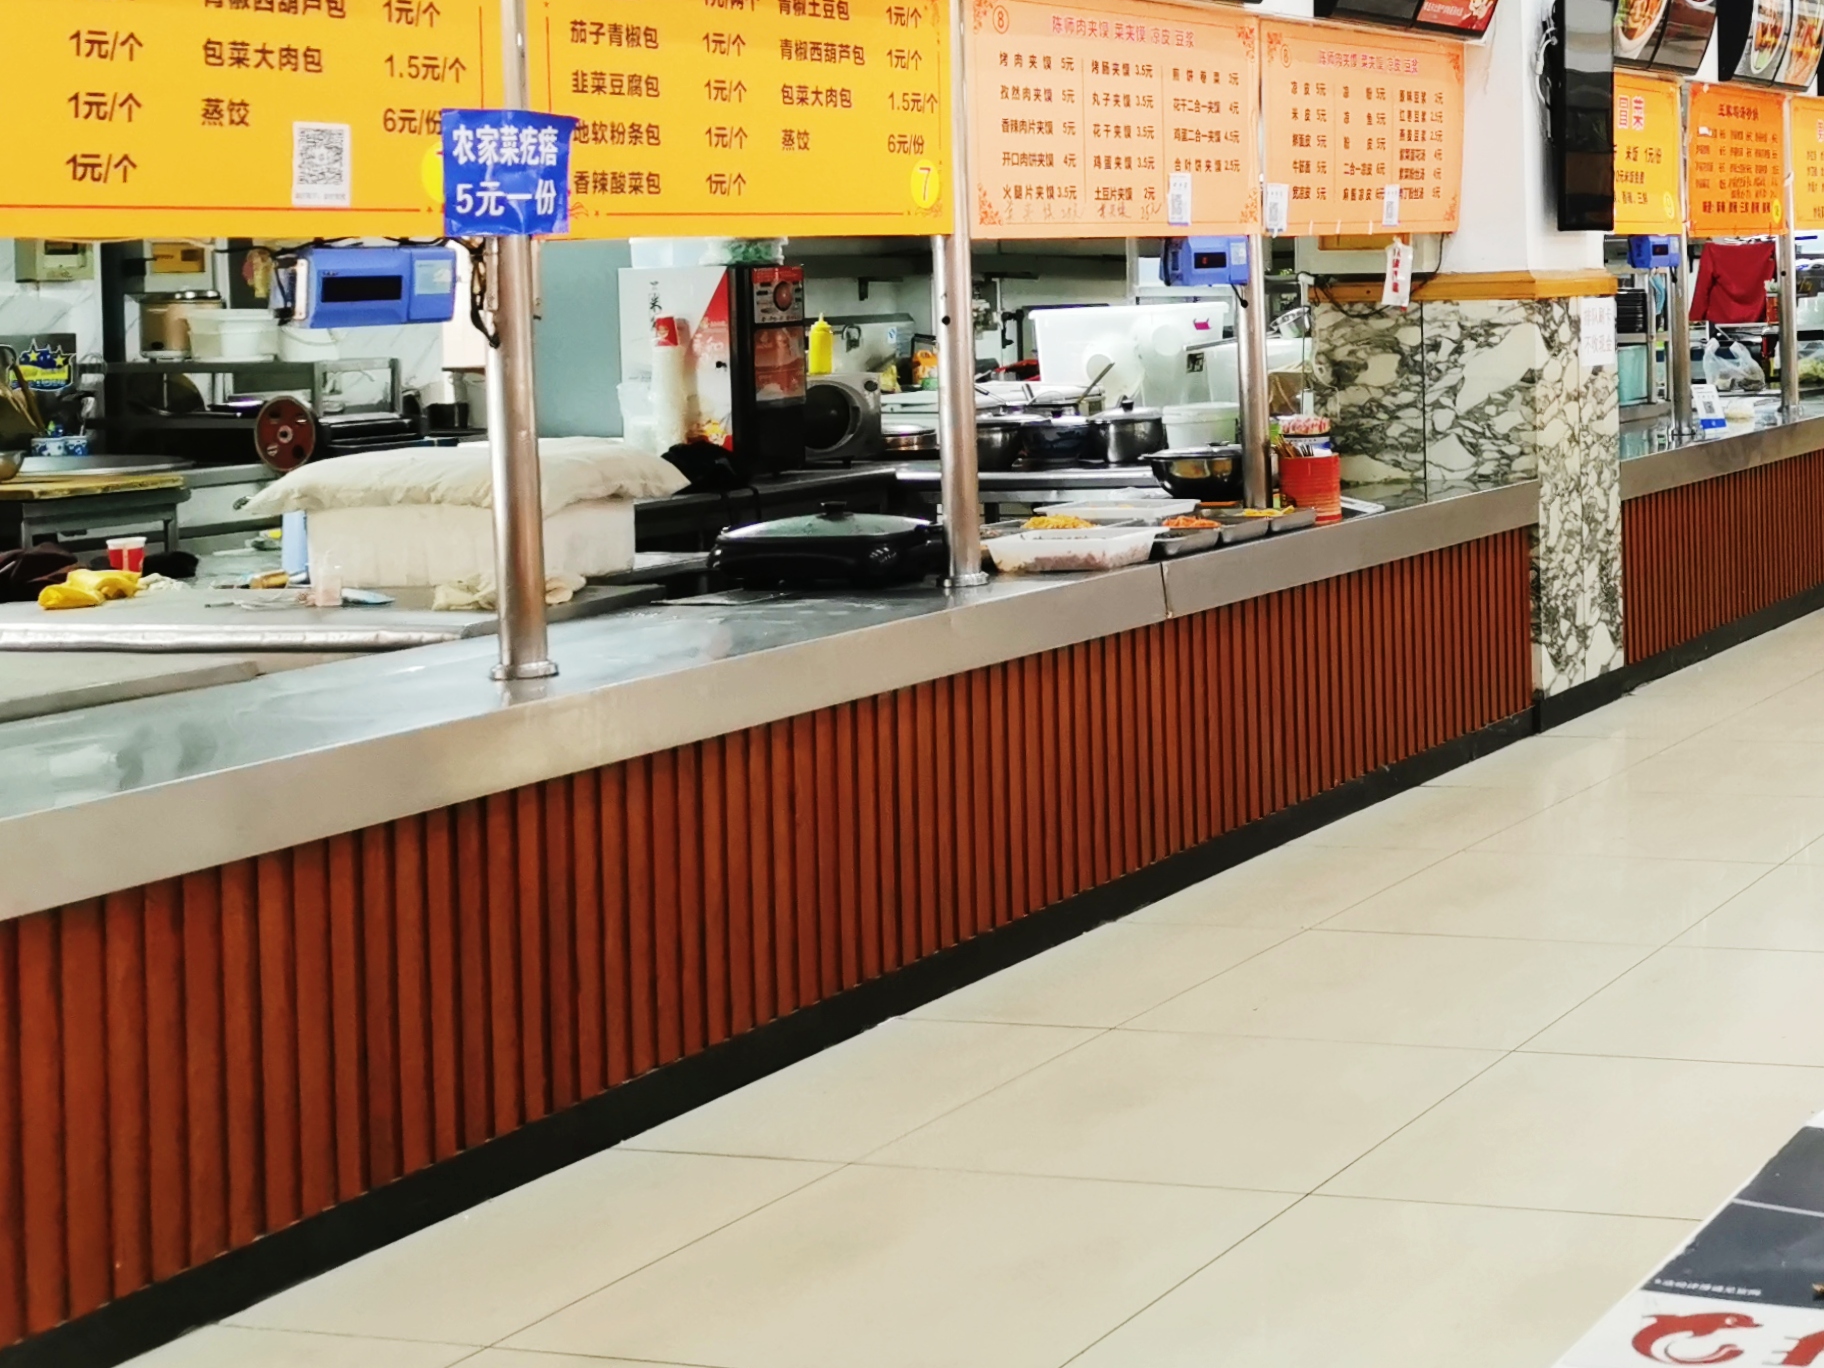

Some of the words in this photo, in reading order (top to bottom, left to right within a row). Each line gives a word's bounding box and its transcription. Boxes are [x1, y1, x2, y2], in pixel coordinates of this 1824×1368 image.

[383, 0, 441, 28] 1元/个
[885, 5, 922, 29] 1元/个
[570, 19, 660, 50] 茄子青椒包
[702, 32, 746, 57] 1元/个
[1052, 15, 1111, 39] 陈师肉夹馍
[1114, 21, 1146, 43] 菜夹馍
[1151, 27, 1171, 47] 凉皮
[1175, 29, 1195, 49] 豆浆
[69, 30, 144, 62] 1元/个
[779, 37, 866, 67] 青椒西葫芦包
[886, 49, 922, 71] 1元/个
[202, 38, 324, 74] 包菜大肉包
[384, 53, 467, 84] 1.5元/个
[999, 52, 1052, 72] 烤肉夹馍
[1061, 57, 1075, 72] 5元
[1135, 64, 1153, 79] 3.5元
[571, 70, 661, 99] 韭菜豆腐包
[704, 79, 748, 104] 1元/个
[780, 83, 853, 110] 包菜大肉包
[888, 91, 939, 114] 1.5元/个
[1000, 84, 1053, 104] 孜然肉夹馍
[1062, 88, 1075, 104] 5元
[1092, 92, 1131, 109] 丸子夹馍
[1136, 94, 1154, 109] 3.5元
[67, 92, 142, 122] 1元/个
[201, 97, 251, 128] 蒸饺
[1229, 101, 1239, 114] 4元
[572, 121, 661, 148] 地软粉条包
[705, 125, 748, 150] 1元/个
[1001, 118, 1054, 136] 香辣肉片夹馍
[1063, 121, 1076, 136] 5元
[1137, 125, 1155, 140] 3.5元
[1224, 129, 1240, 144] 4.5元
[452, 124, 559, 166] 农家菜疙瘩
[781, 128, 811, 153] 蒸饺
[888, 133, 925, 155] 6元/份
[66, 154, 138, 184] 1元/个
[1063, 153, 1077, 168] 4元
[1093, 155, 1132, 171] 鸡蛋夹馍
[1137, 156, 1155, 171] 3.5元
[1224, 159, 1241, 173] 2.5元
[455, 178, 557, 217] 5元一份
[573, 171, 661, 196] 香辣酸菜包
[706, 173, 747, 197] 1元/个
[918, 167, 931, 202] 7
[1057, 185, 1077, 201] 3.5元
[1094, 186, 1133, 201] 土豆片夹馍
[1144, 186, 1156, 202] 2元
